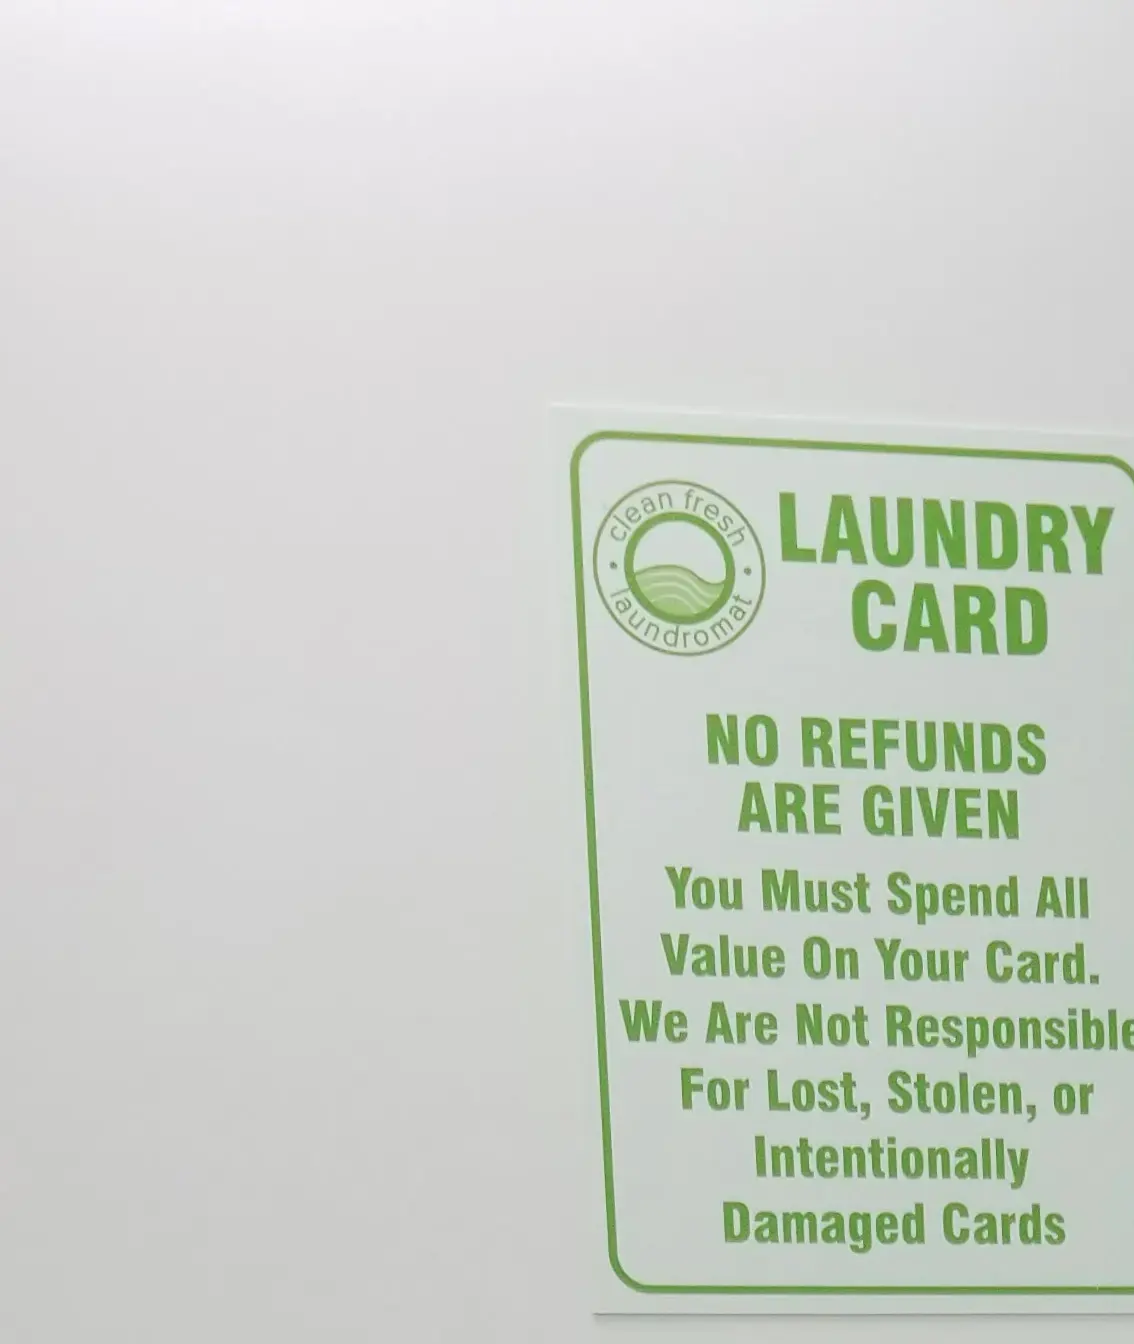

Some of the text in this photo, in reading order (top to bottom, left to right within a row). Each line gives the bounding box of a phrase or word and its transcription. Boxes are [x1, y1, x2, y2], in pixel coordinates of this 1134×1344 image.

[607, 488, 747, 547] clean fresh
[779, 492, 1114, 575] LAUNDRY
[609, 587, 752, 649] laundromat
[851, 579, 1050, 656] CARD
[705, 713, 1047, 775] NO REFUNDS
[738, 781, 1020, 840] ARE GIVEN
[665, 866, 1089, 925] You Must Spend All
[660, 933, 1100, 984] Value On Your Card.
[619, 999, 688, 1042] We
[705, 1001, 779, 1045] Are
[796, 1003, 870, 1047] Not
[680, 1067, 1094, 1123] For Lost, Stolen, or
[754, 1136, 1029, 1189] Intentionally
[723, 1202, 1066, 1254] Damaged Cards
